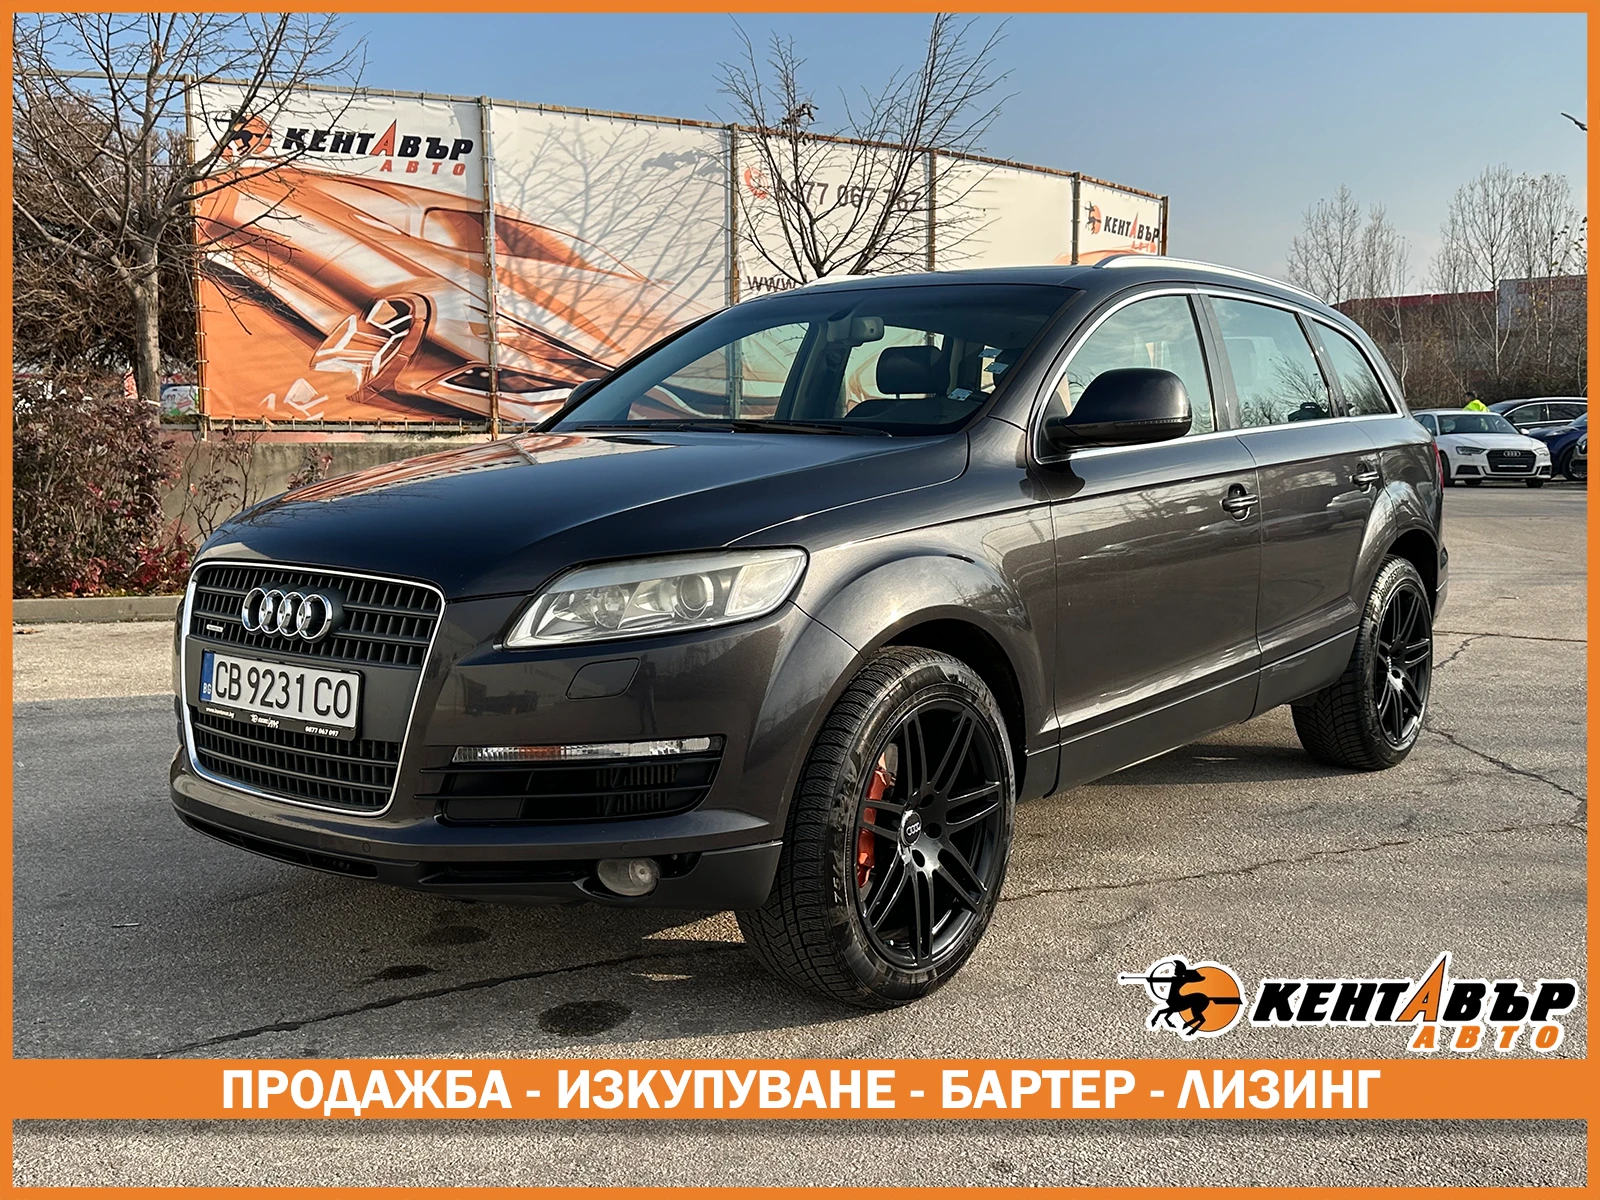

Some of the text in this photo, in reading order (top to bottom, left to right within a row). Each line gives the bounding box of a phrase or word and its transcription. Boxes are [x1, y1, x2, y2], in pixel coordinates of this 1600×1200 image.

[281, 119, 474, 161] КЕНТАВЪР
[380, 159, 466, 176] АВТО
[1103, 212, 1160, 243] КЕНТАВЪР
[202, 682, 212, 695] BG
[215, 661, 242, 701] CB
[247, 666, 305, 713] 9231
